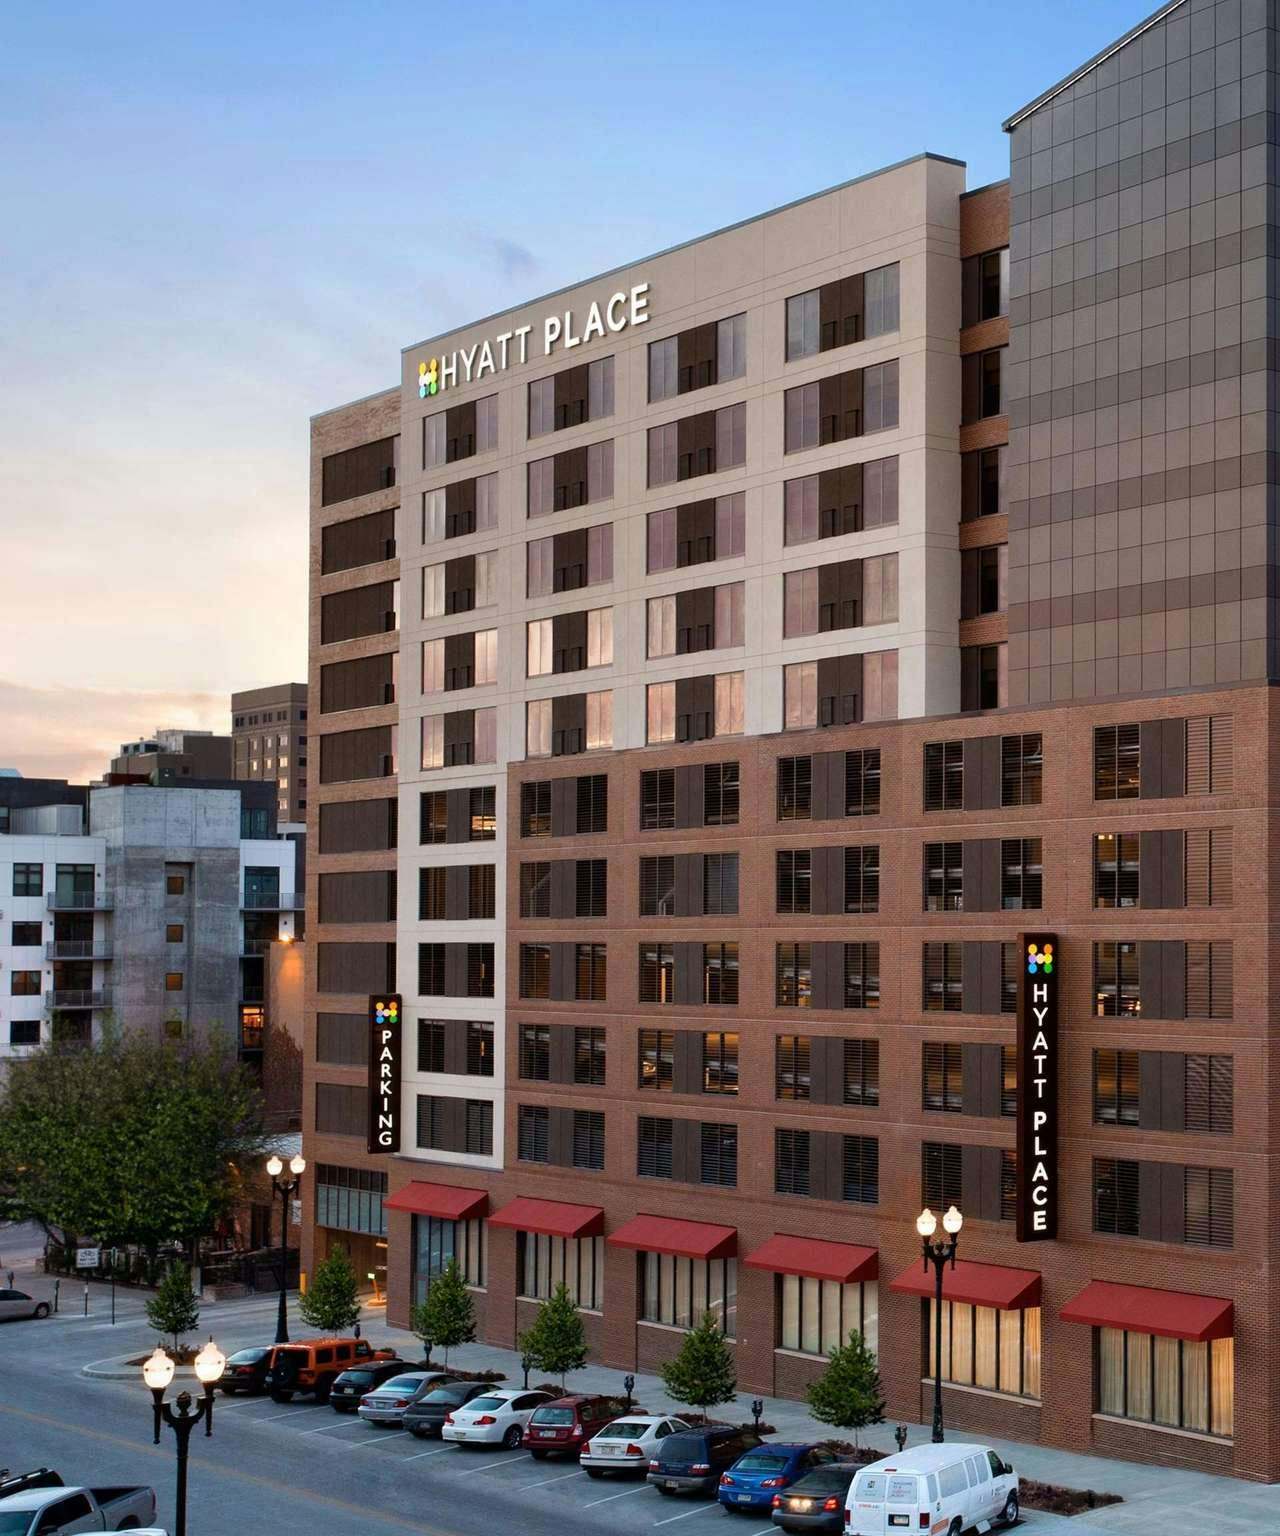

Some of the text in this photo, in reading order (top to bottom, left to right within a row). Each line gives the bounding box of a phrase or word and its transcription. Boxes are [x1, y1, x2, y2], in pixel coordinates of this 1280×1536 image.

[440, 283, 649, 390] HYATT PLACE
[378, 1030, 393, 1146] PARKING
[1032, 983, 1049, 1231] HYATT PLACE
